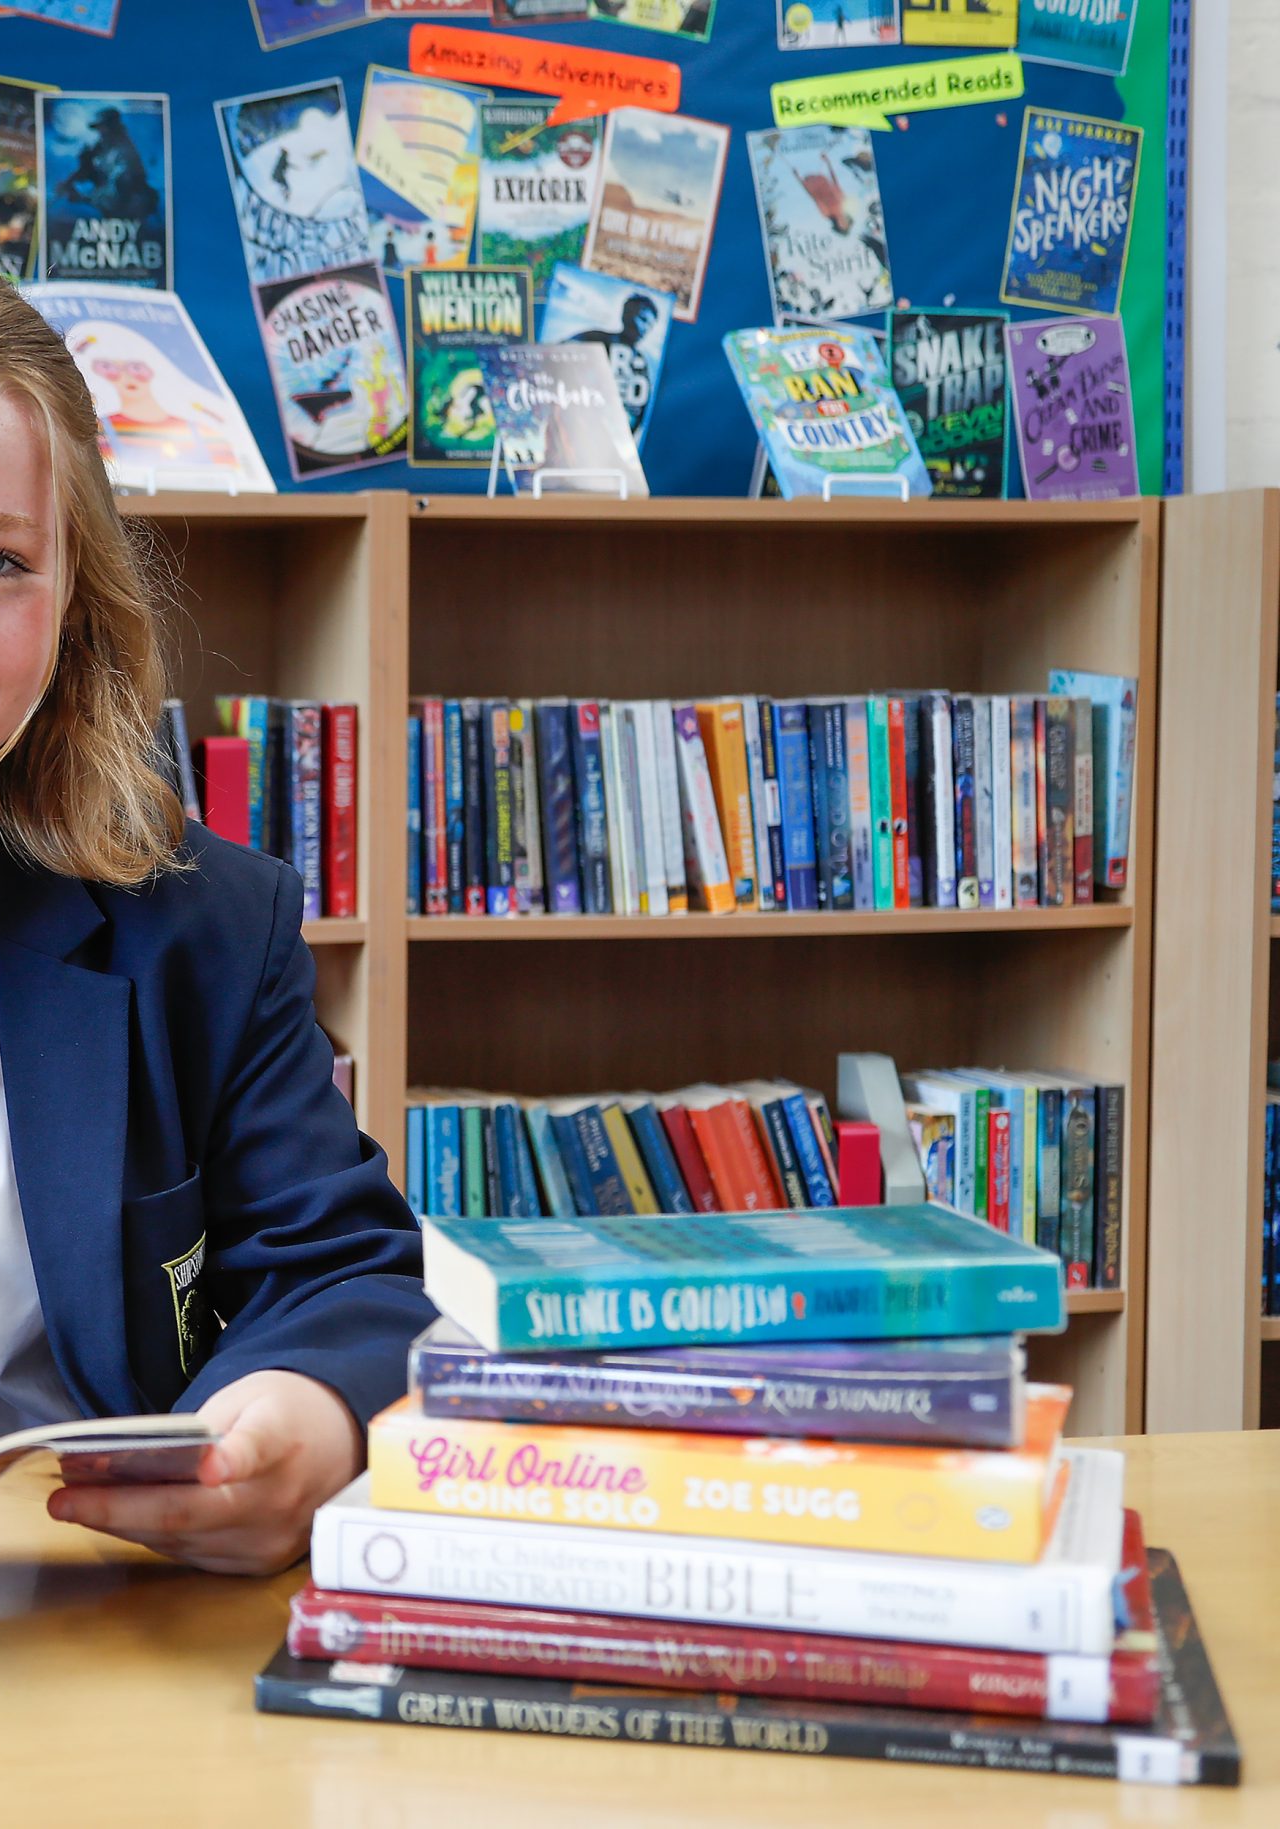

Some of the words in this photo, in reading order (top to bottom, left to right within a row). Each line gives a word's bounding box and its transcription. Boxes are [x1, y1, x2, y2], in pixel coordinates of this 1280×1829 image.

[422, 40, 522, 80] Amazing
[534, 56, 669, 98] Adventures
[777, 73, 938, 117] Recommended
[946, 66, 1014, 94] Reads
[493, 175, 588, 205] EXPLORER
[1033, 154, 1133, 216] NIGHT
[72, 217, 141, 243] ANDY
[1014, 193, 1129, 261] SPEAKERS
[50, 240, 163, 271] McNAB
[808, 247, 872, 284] Spirit
[271, 281, 353, 335] CHASING
[418, 294, 523, 337] WENTON
[286, 306, 384, 365] DANGER
[893, 321, 1005, 388] SNAKE
[506, 381, 608, 413] Climbers
[784, 369, 862, 403] RAN
[923, 361, 1004, 419] TRAP
[786, 408, 889, 448] COUNTRY
[928, 402, 1004, 437] KEVIN
[1070, 422, 1125, 452] CRIME
[526, 1287, 623, 1338] SILENCE
[629, 1287, 655, 1332] IS
[661, 1283, 787, 1334] GOLDFISH
[408, 1437, 497, 1492] Girl
[505, 1443, 647, 1494] Online
[435, 1481, 554, 1517] GOING
[562, 1491, 661, 1526] SOLO
[683, 1476, 753, 1512] ZOE
[761, 1484, 861, 1521] SUGG
[427, 1565, 628, 1604] ILLUSTRATED
[645, 1555, 821, 1624] BIBLE
[380, 1611, 570, 1667] MYTHOLOGY
[653, 1636, 779, 1686] WORLD
[397, 1690, 488, 1728] GREAT
[492, 1698, 620, 1739] WONDERS
[624, 1708, 663, 1742] OF
[666, 1711, 726, 1747] THE
[732, 1716, 829, 1753] WORLD
